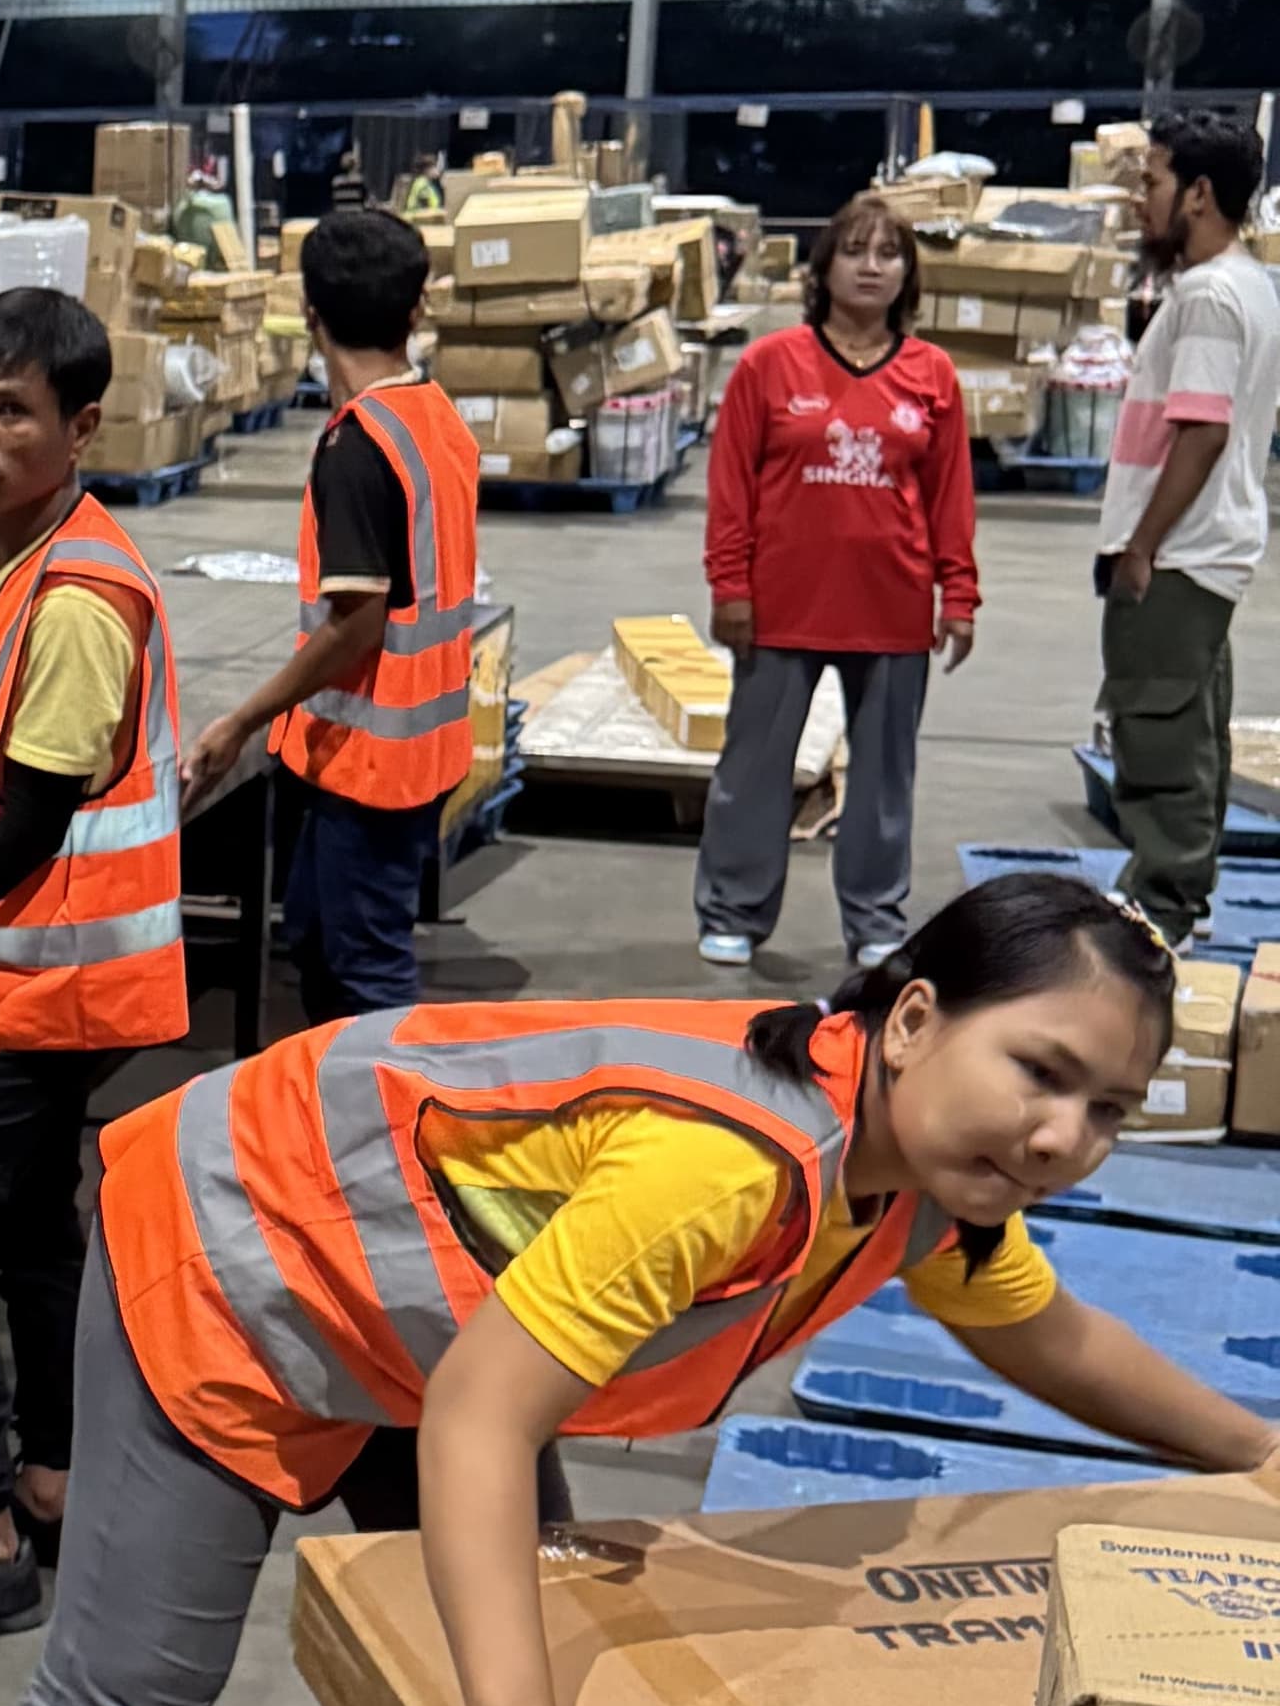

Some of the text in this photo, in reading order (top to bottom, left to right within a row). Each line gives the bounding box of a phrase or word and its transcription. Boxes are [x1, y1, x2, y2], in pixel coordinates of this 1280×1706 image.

[802, 466, 895, 488] SINGHA
[1100, 1539, 1231, 1564] Sweetened
[853, 1613, 1046, 1651] TRAM
